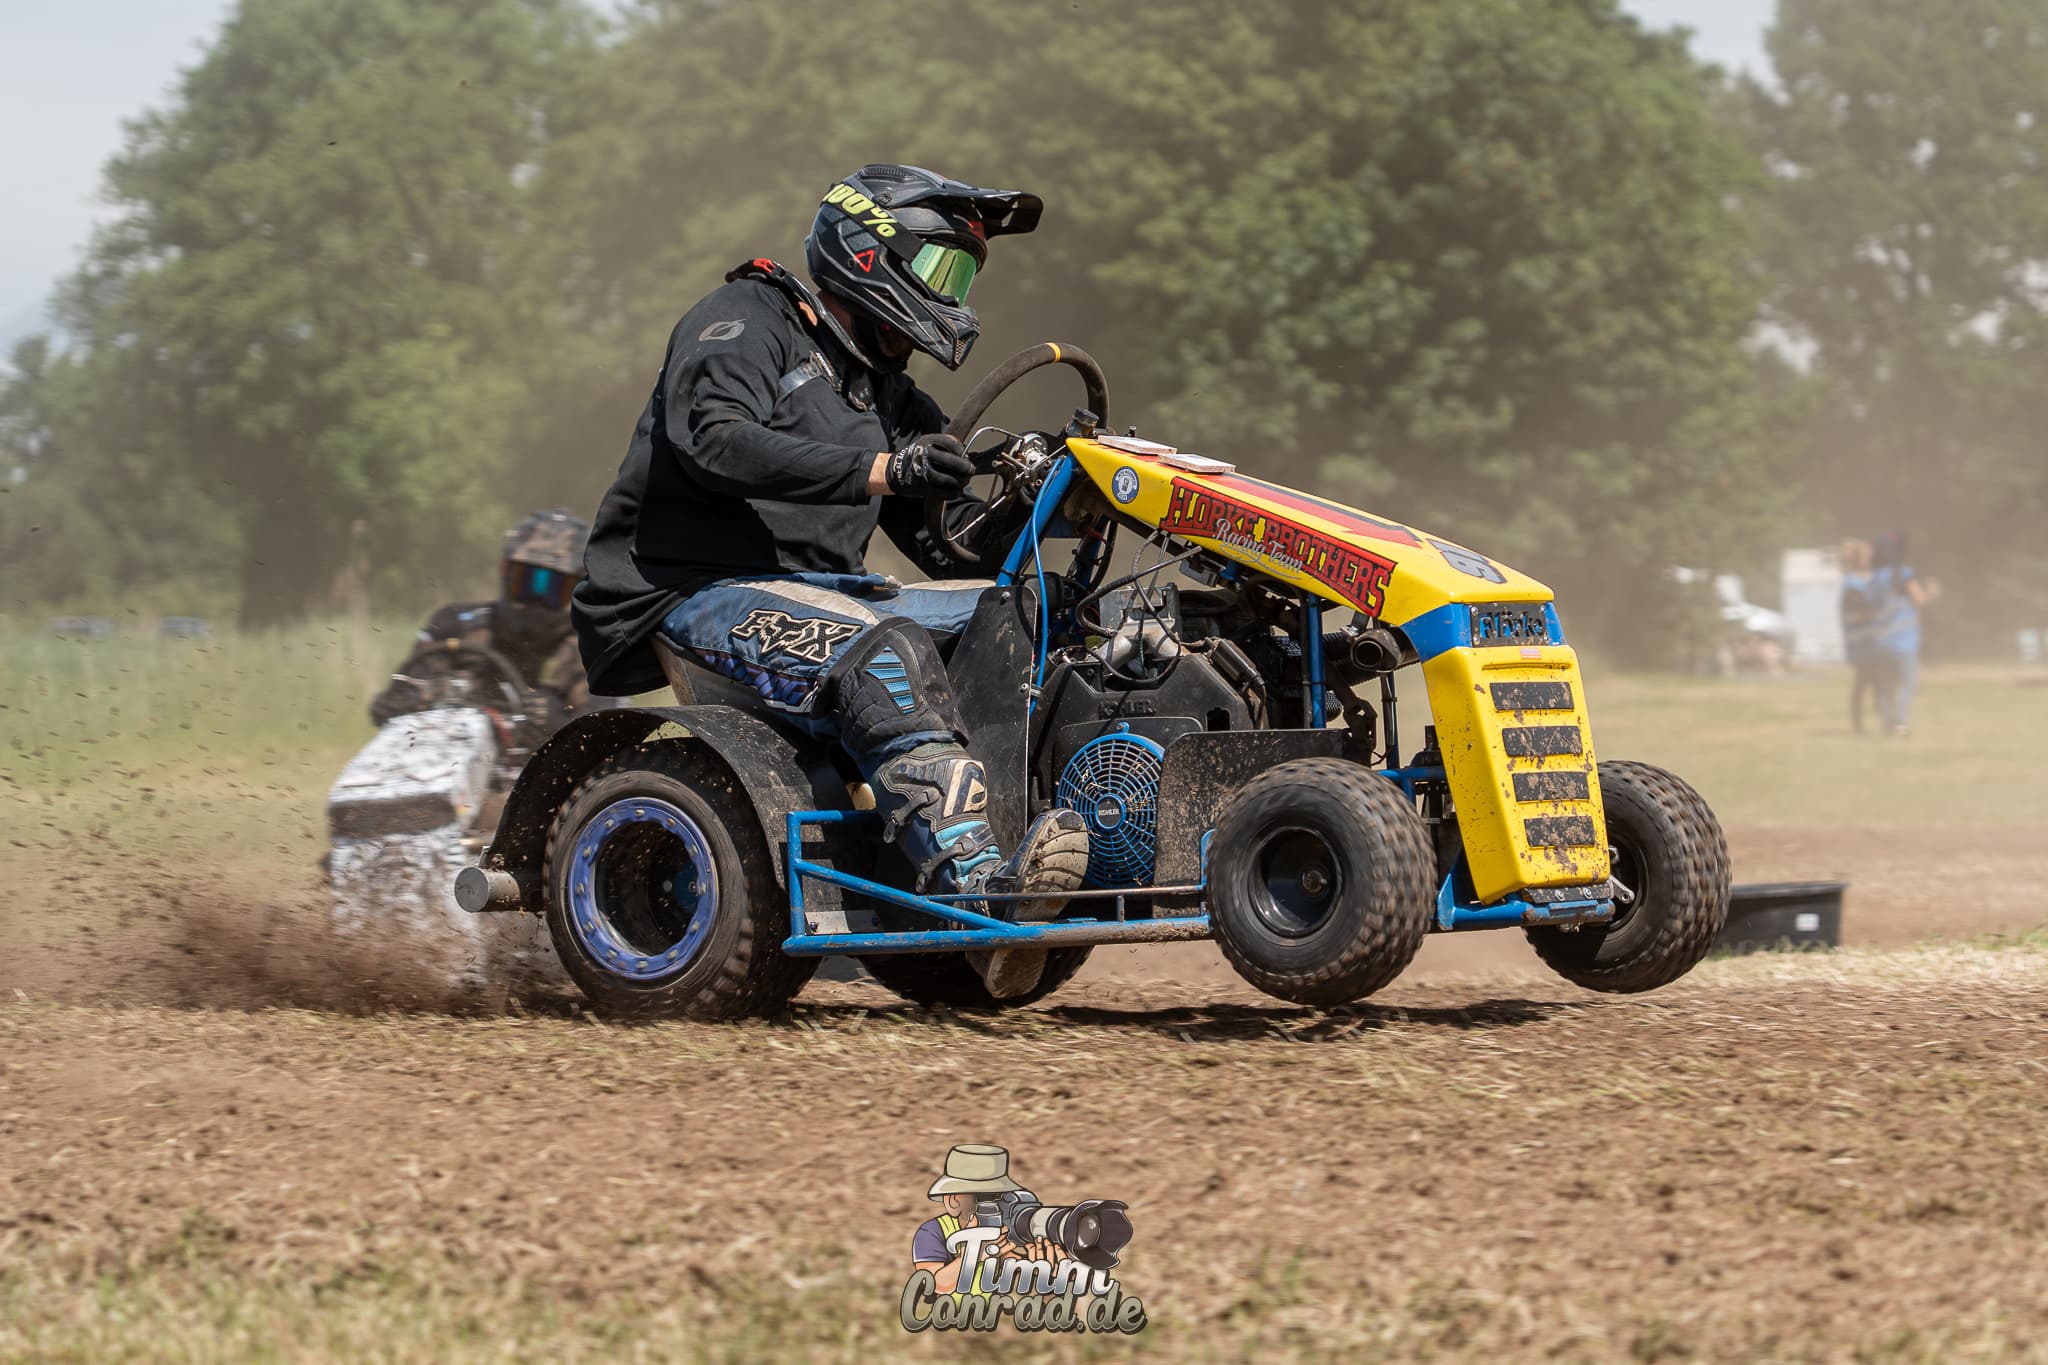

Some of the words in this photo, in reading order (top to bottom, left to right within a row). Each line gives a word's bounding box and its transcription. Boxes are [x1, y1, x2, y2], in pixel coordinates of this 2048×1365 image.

[822, 184, 897, 238] 100%
[1212, 518, 1266, 561] Racing
[1268, 540, 1303, 573] Team
[1263, 518, 1394, 617] BROTHERS
[731, 608, 862, 663] FOX
